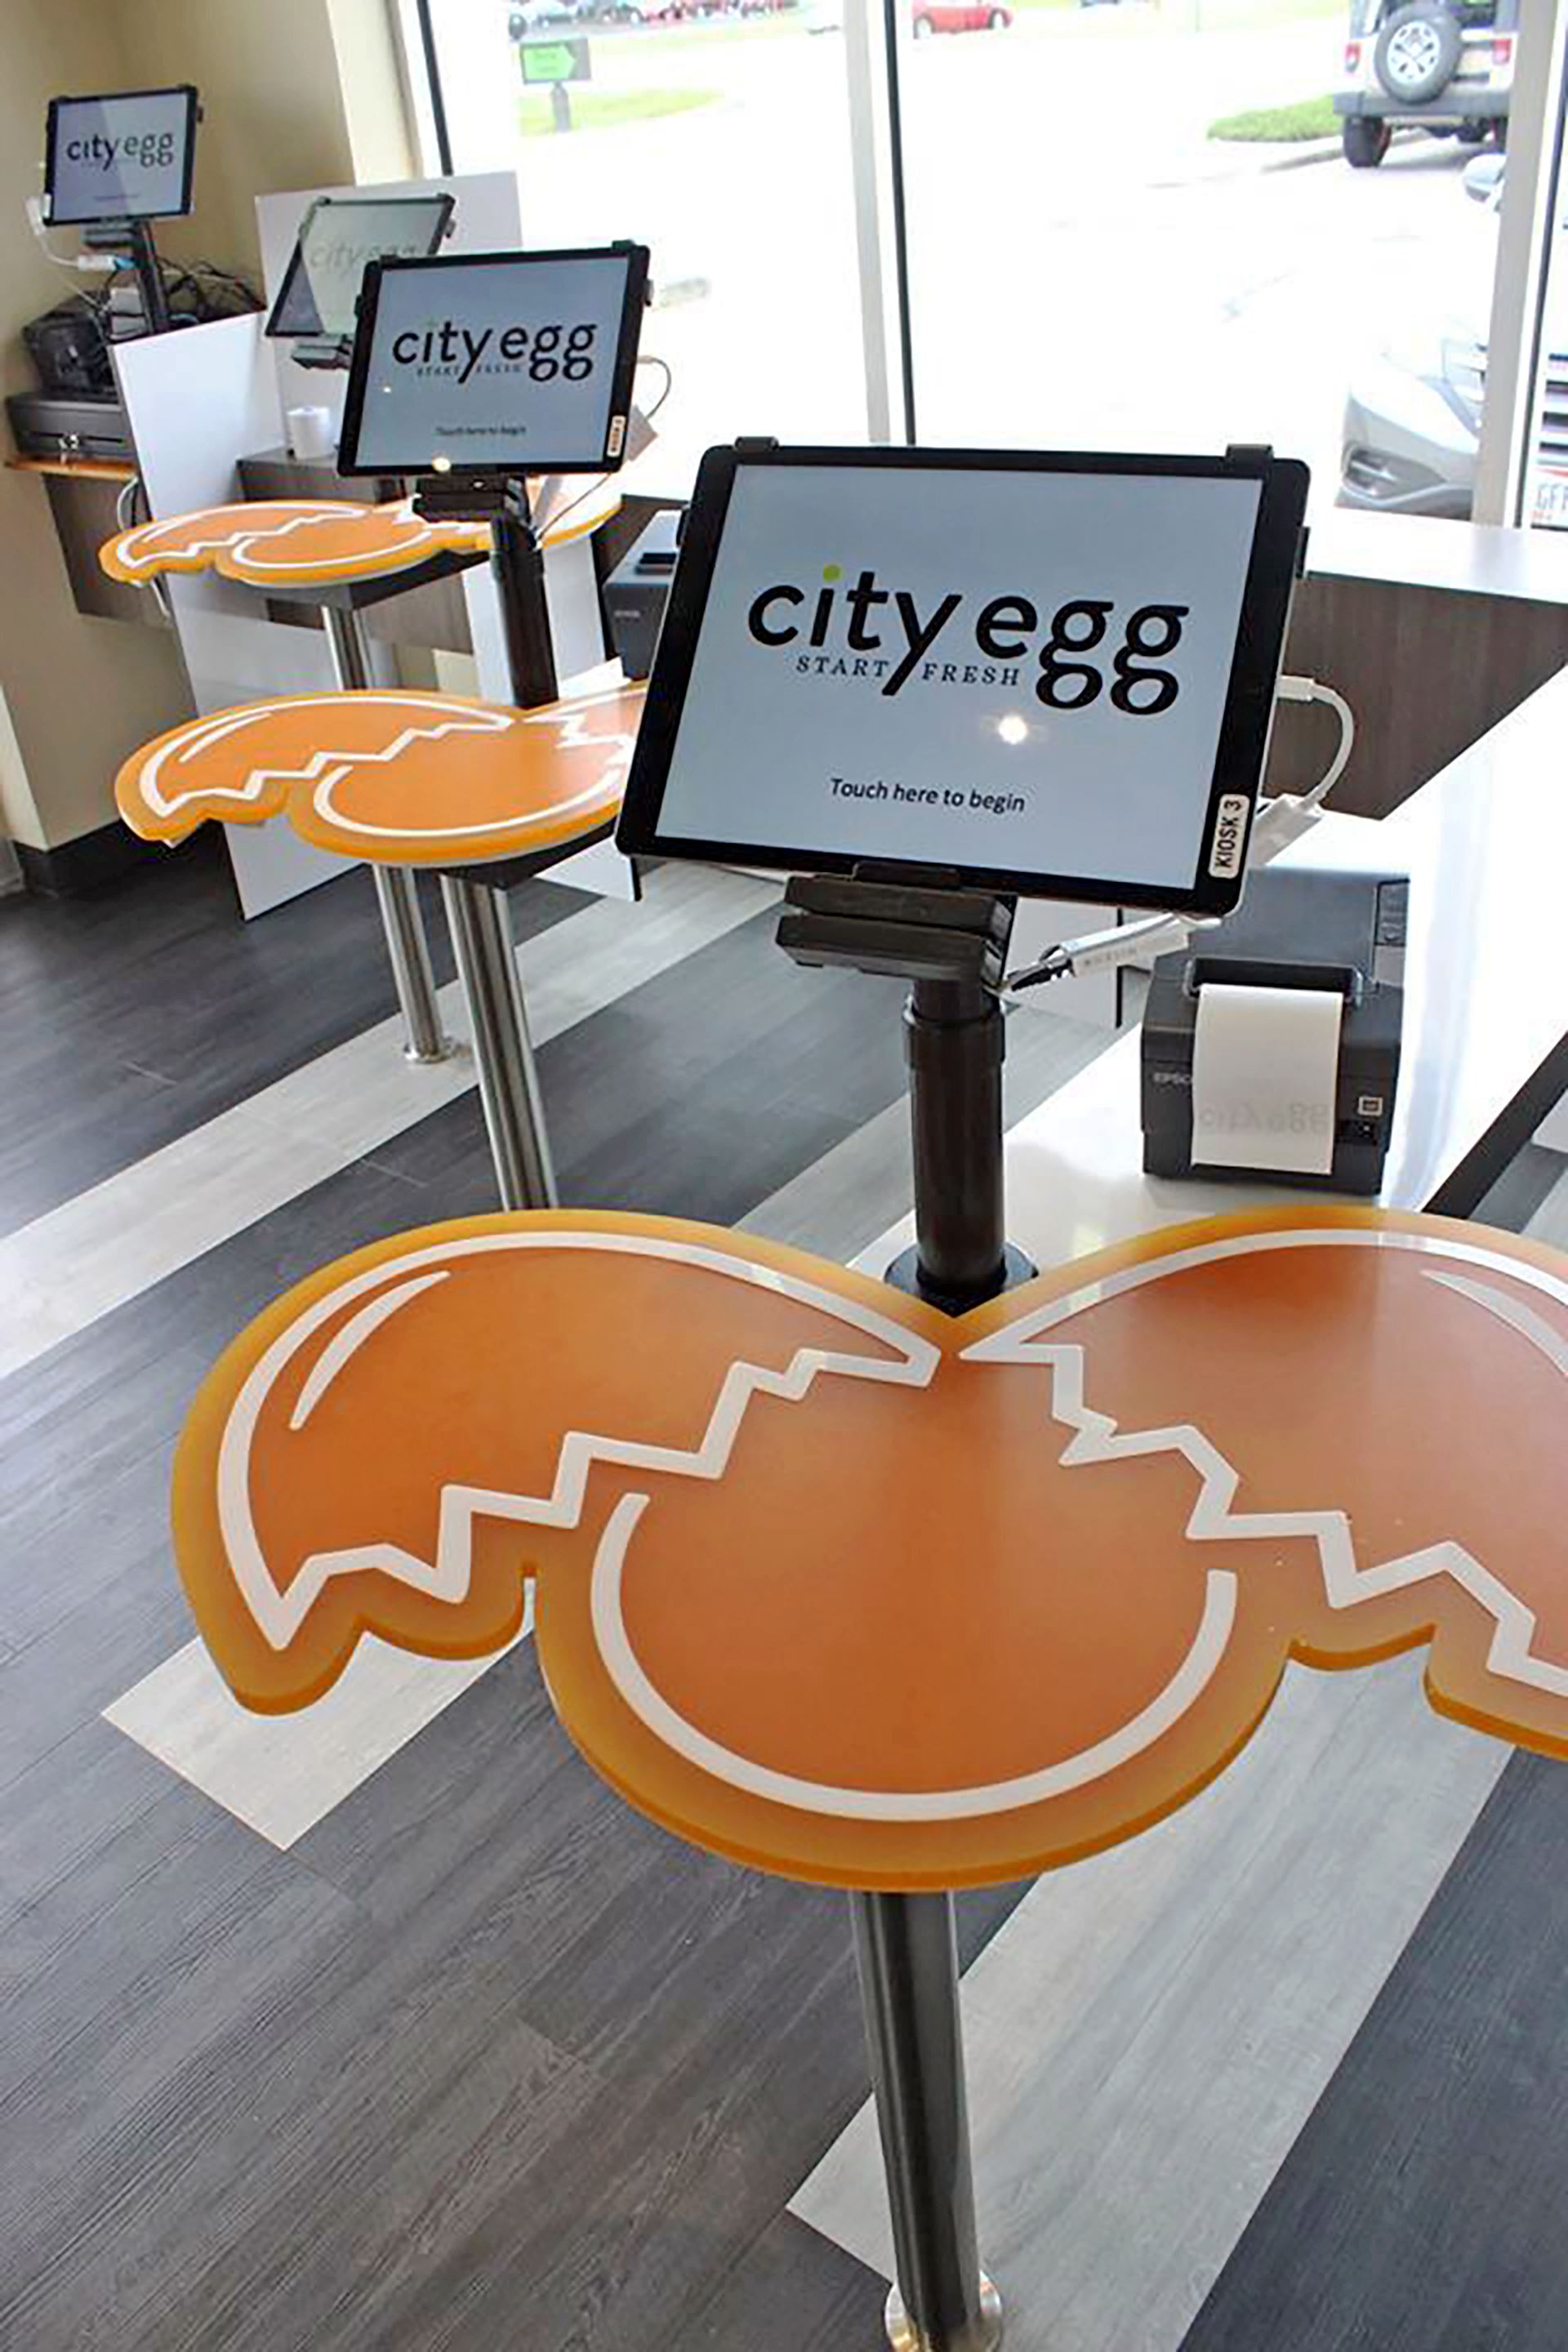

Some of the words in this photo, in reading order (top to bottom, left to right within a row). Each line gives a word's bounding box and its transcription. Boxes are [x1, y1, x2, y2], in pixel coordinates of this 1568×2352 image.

[66, 134, 120, 172] city
[124, 132, 174, 167] egg
[393, 318, 493, 384] city
[499, 323, 597, 382] egg
[749, 564, 963, 697] city
[976, 595, 1189, 715] egg
[795, 656, 889, 678] START
[921, 662, 1021, 687] FRESH
[831, 777, 889, 800] Touch
[893, 782, 938, 804] here
[942, 789, 964, 807] to
[969, 788, 1026, 814] begin
[1223, 800, 1242, 812] 3
[1214, 816, 1239, 868] KIOSK
[1153, 1071, 1193, 1085] EPSO
